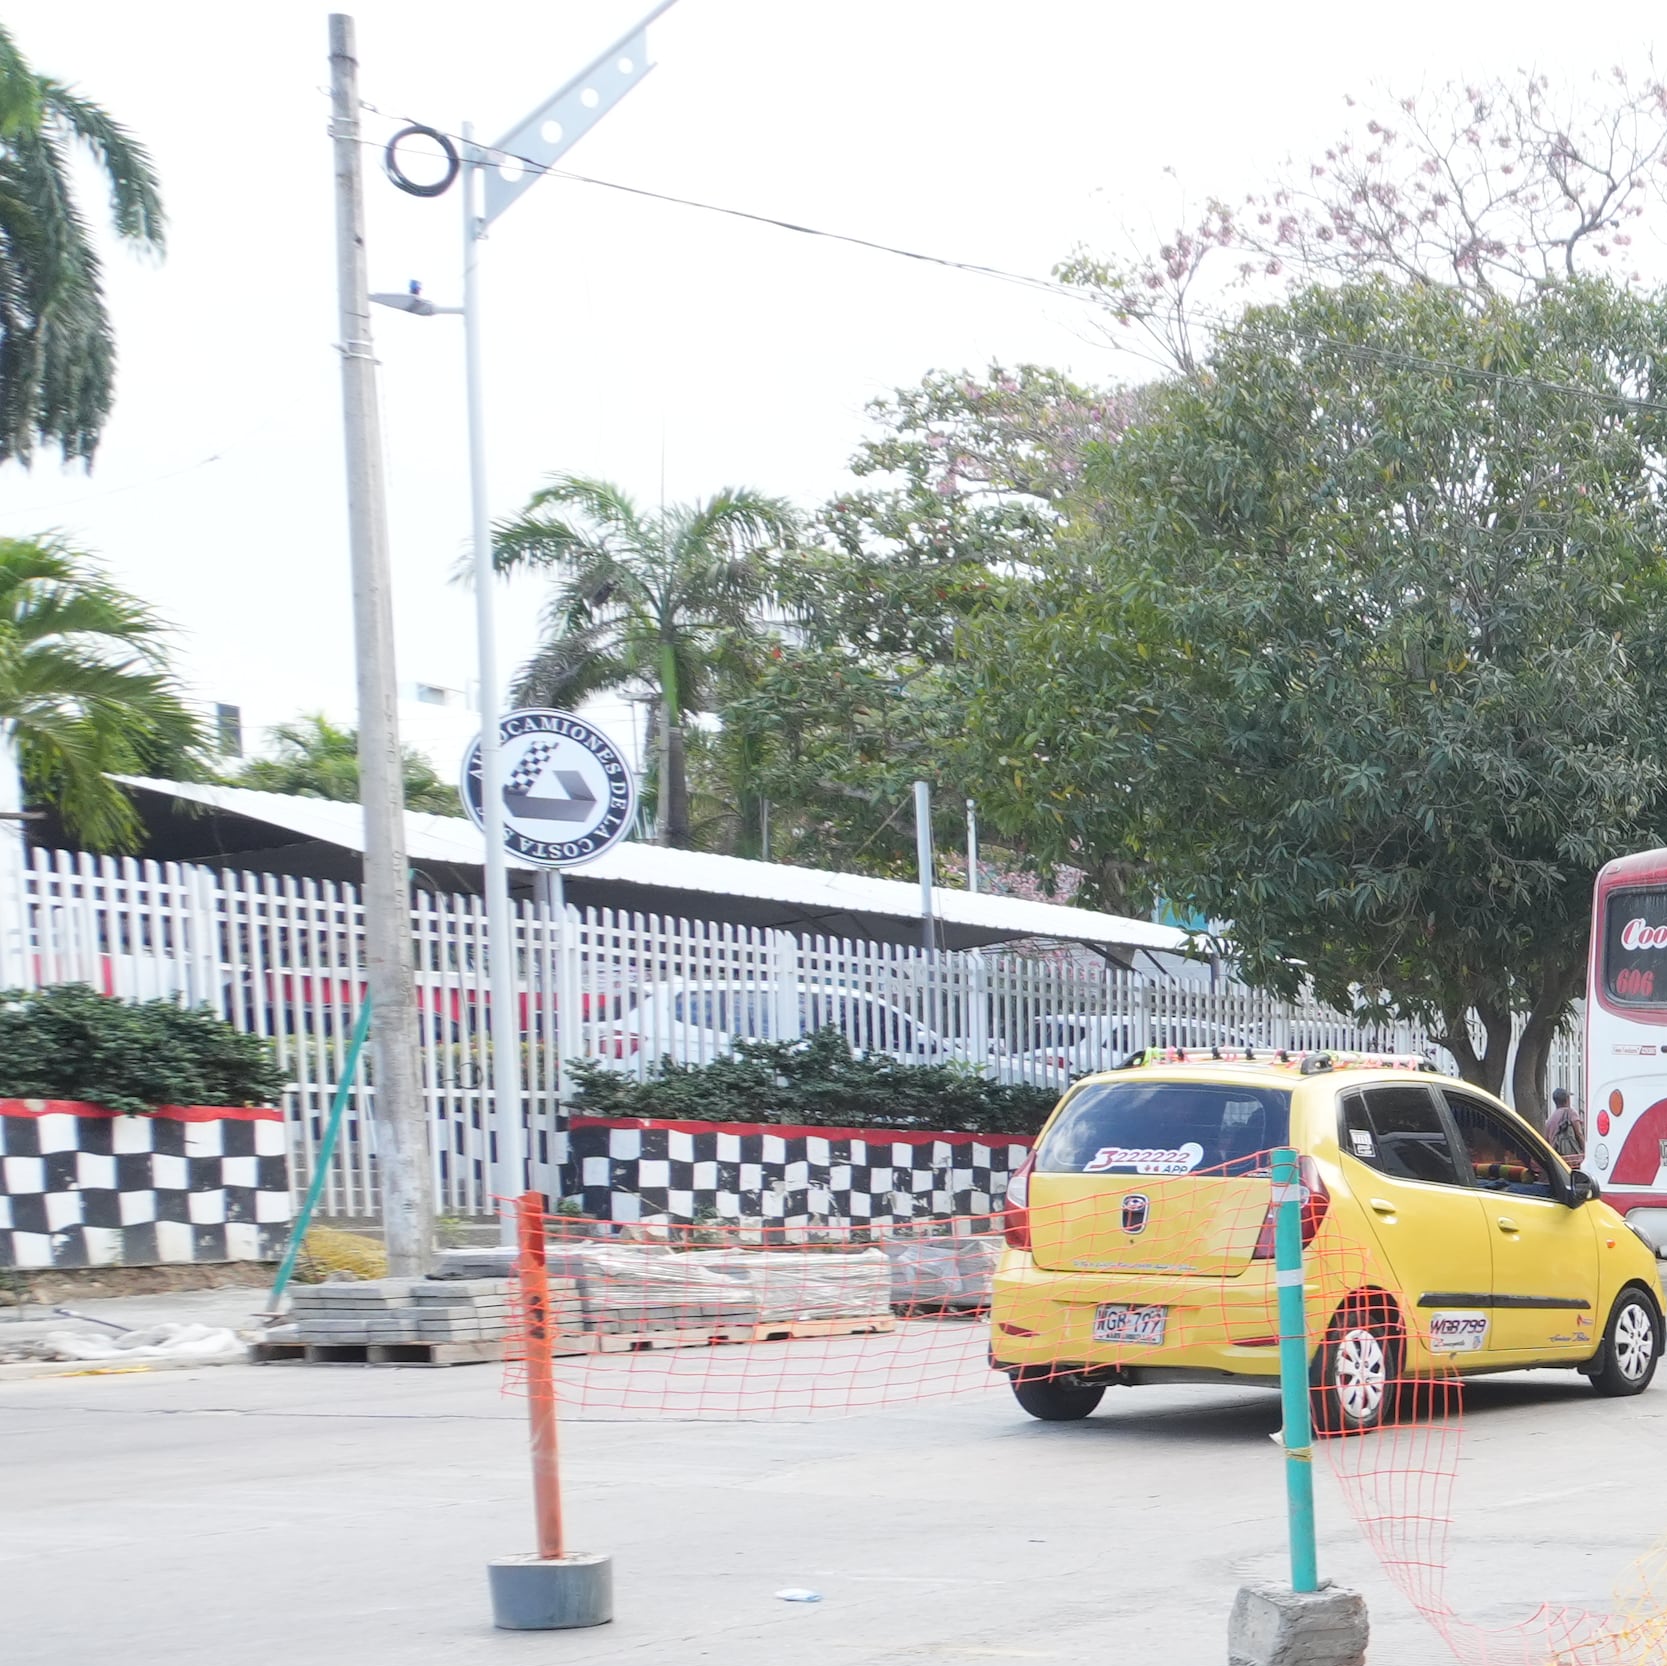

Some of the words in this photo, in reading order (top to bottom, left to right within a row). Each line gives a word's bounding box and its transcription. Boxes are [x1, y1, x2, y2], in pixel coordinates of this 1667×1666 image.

[468, 716, 621, 781] AOCAMIONES
[610, 782, 627, 810] DE
[595, 814, 621, 839] LA
[519, 837, 594, 859] COSTA
[1616, 968, 1655, 996] 606
[1089, 1150, 1191, 1169] 3222222
[1162, 1165, 1188, 1174] APP
[1430, 1319, 1487, 1335] WGB799
